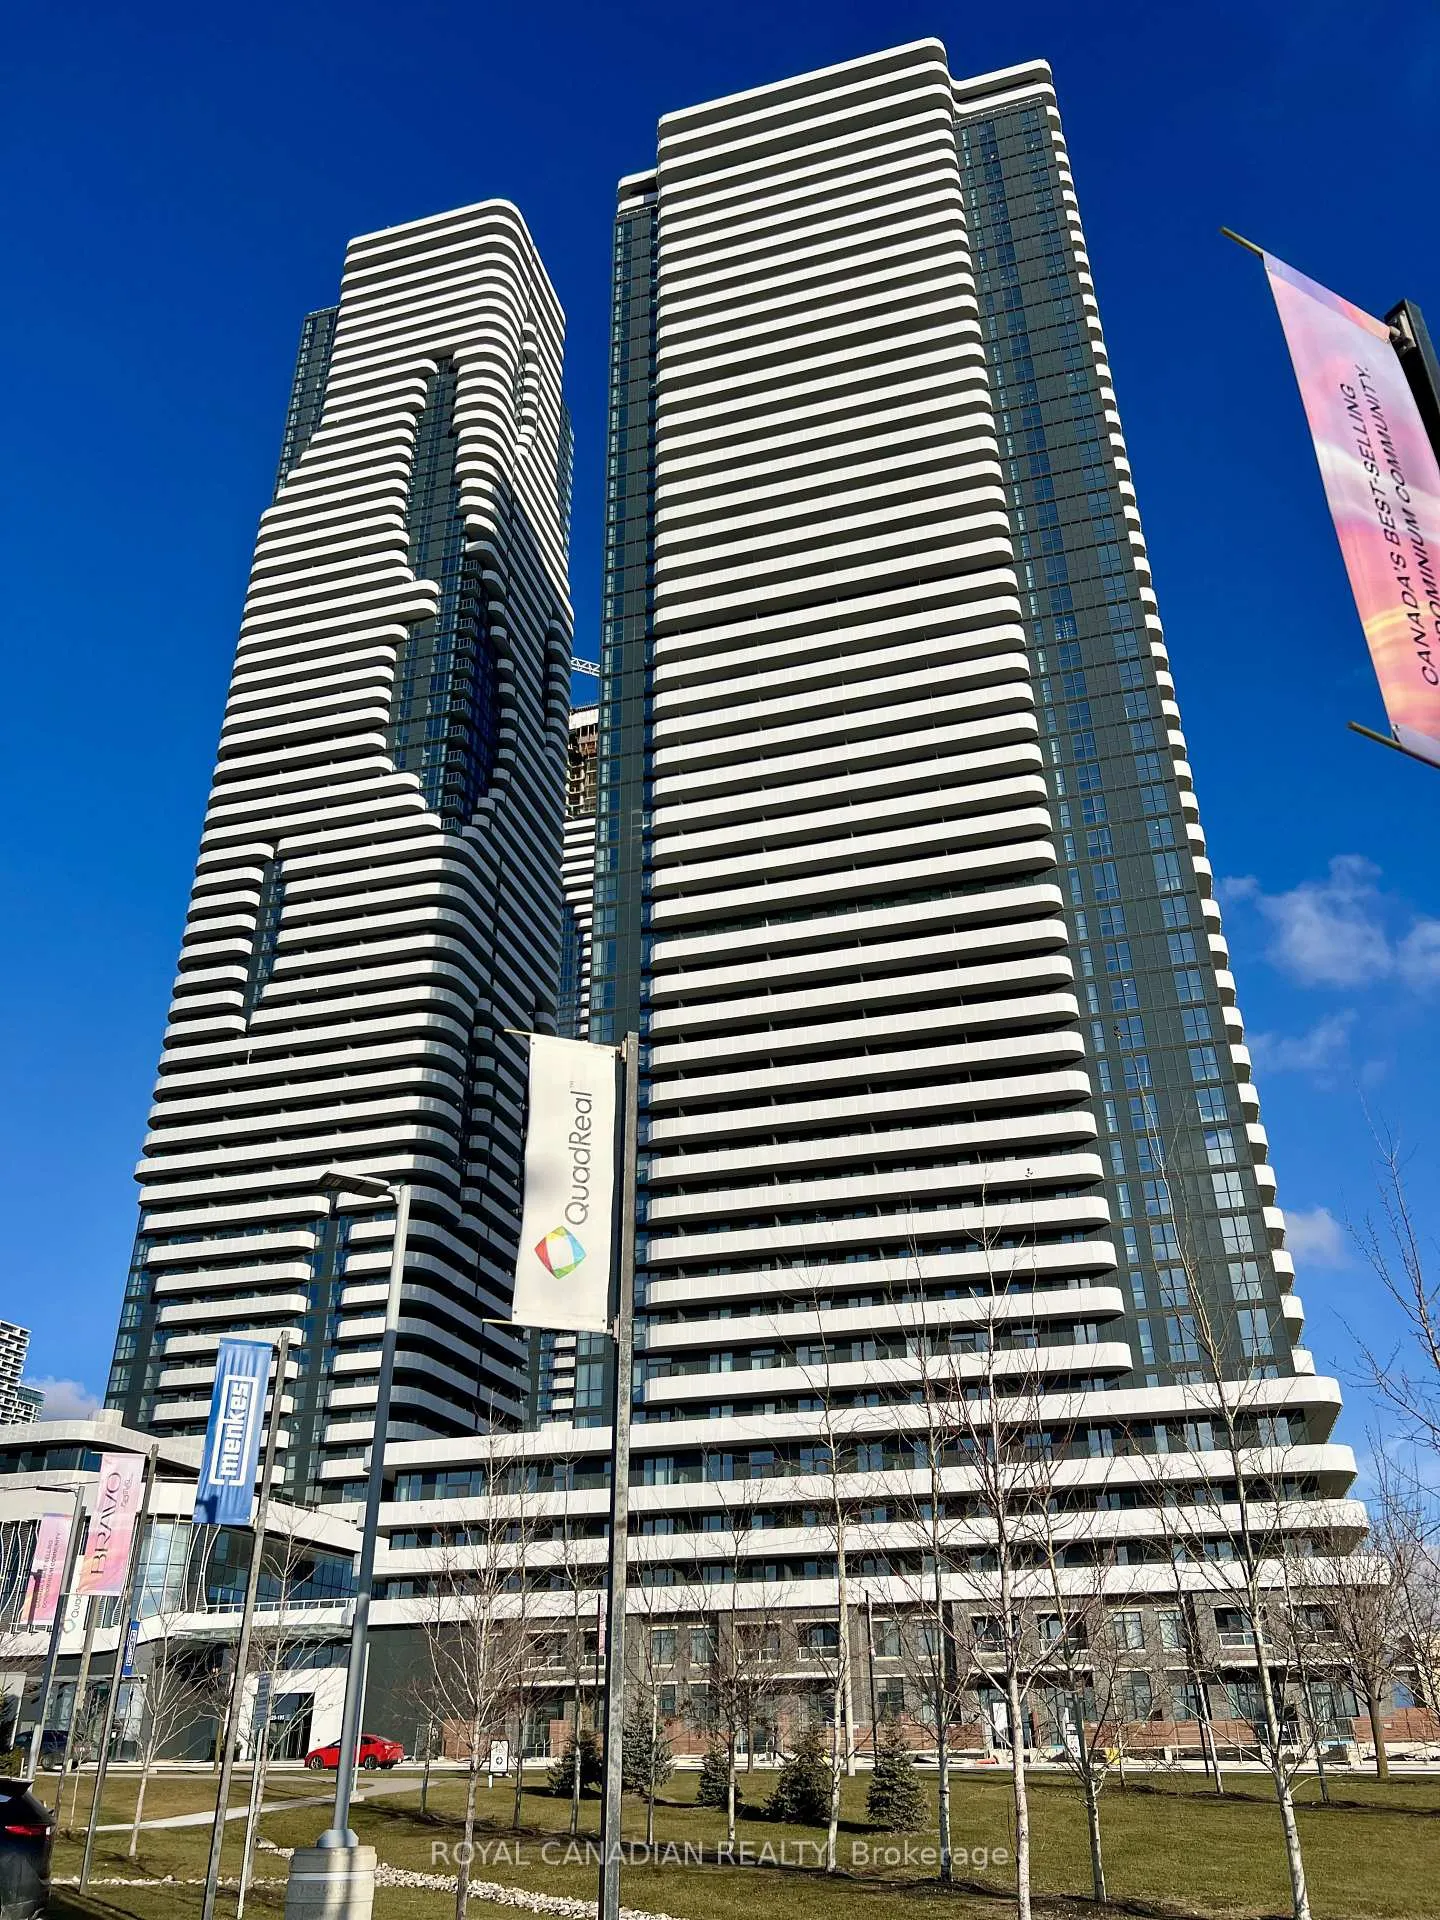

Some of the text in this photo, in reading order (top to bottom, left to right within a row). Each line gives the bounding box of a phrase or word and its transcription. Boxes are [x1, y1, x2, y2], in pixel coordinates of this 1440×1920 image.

[1340, 383, 1439, 686] CANADA'S BEST-SELLING
[1402, 508, 1440, 641] OMINIUM
[565, 1090, 593, 1225] QuadReal
[220, 1382, 249, 1476] menkes
[91, 1472, 121, 1574] BRAVO
